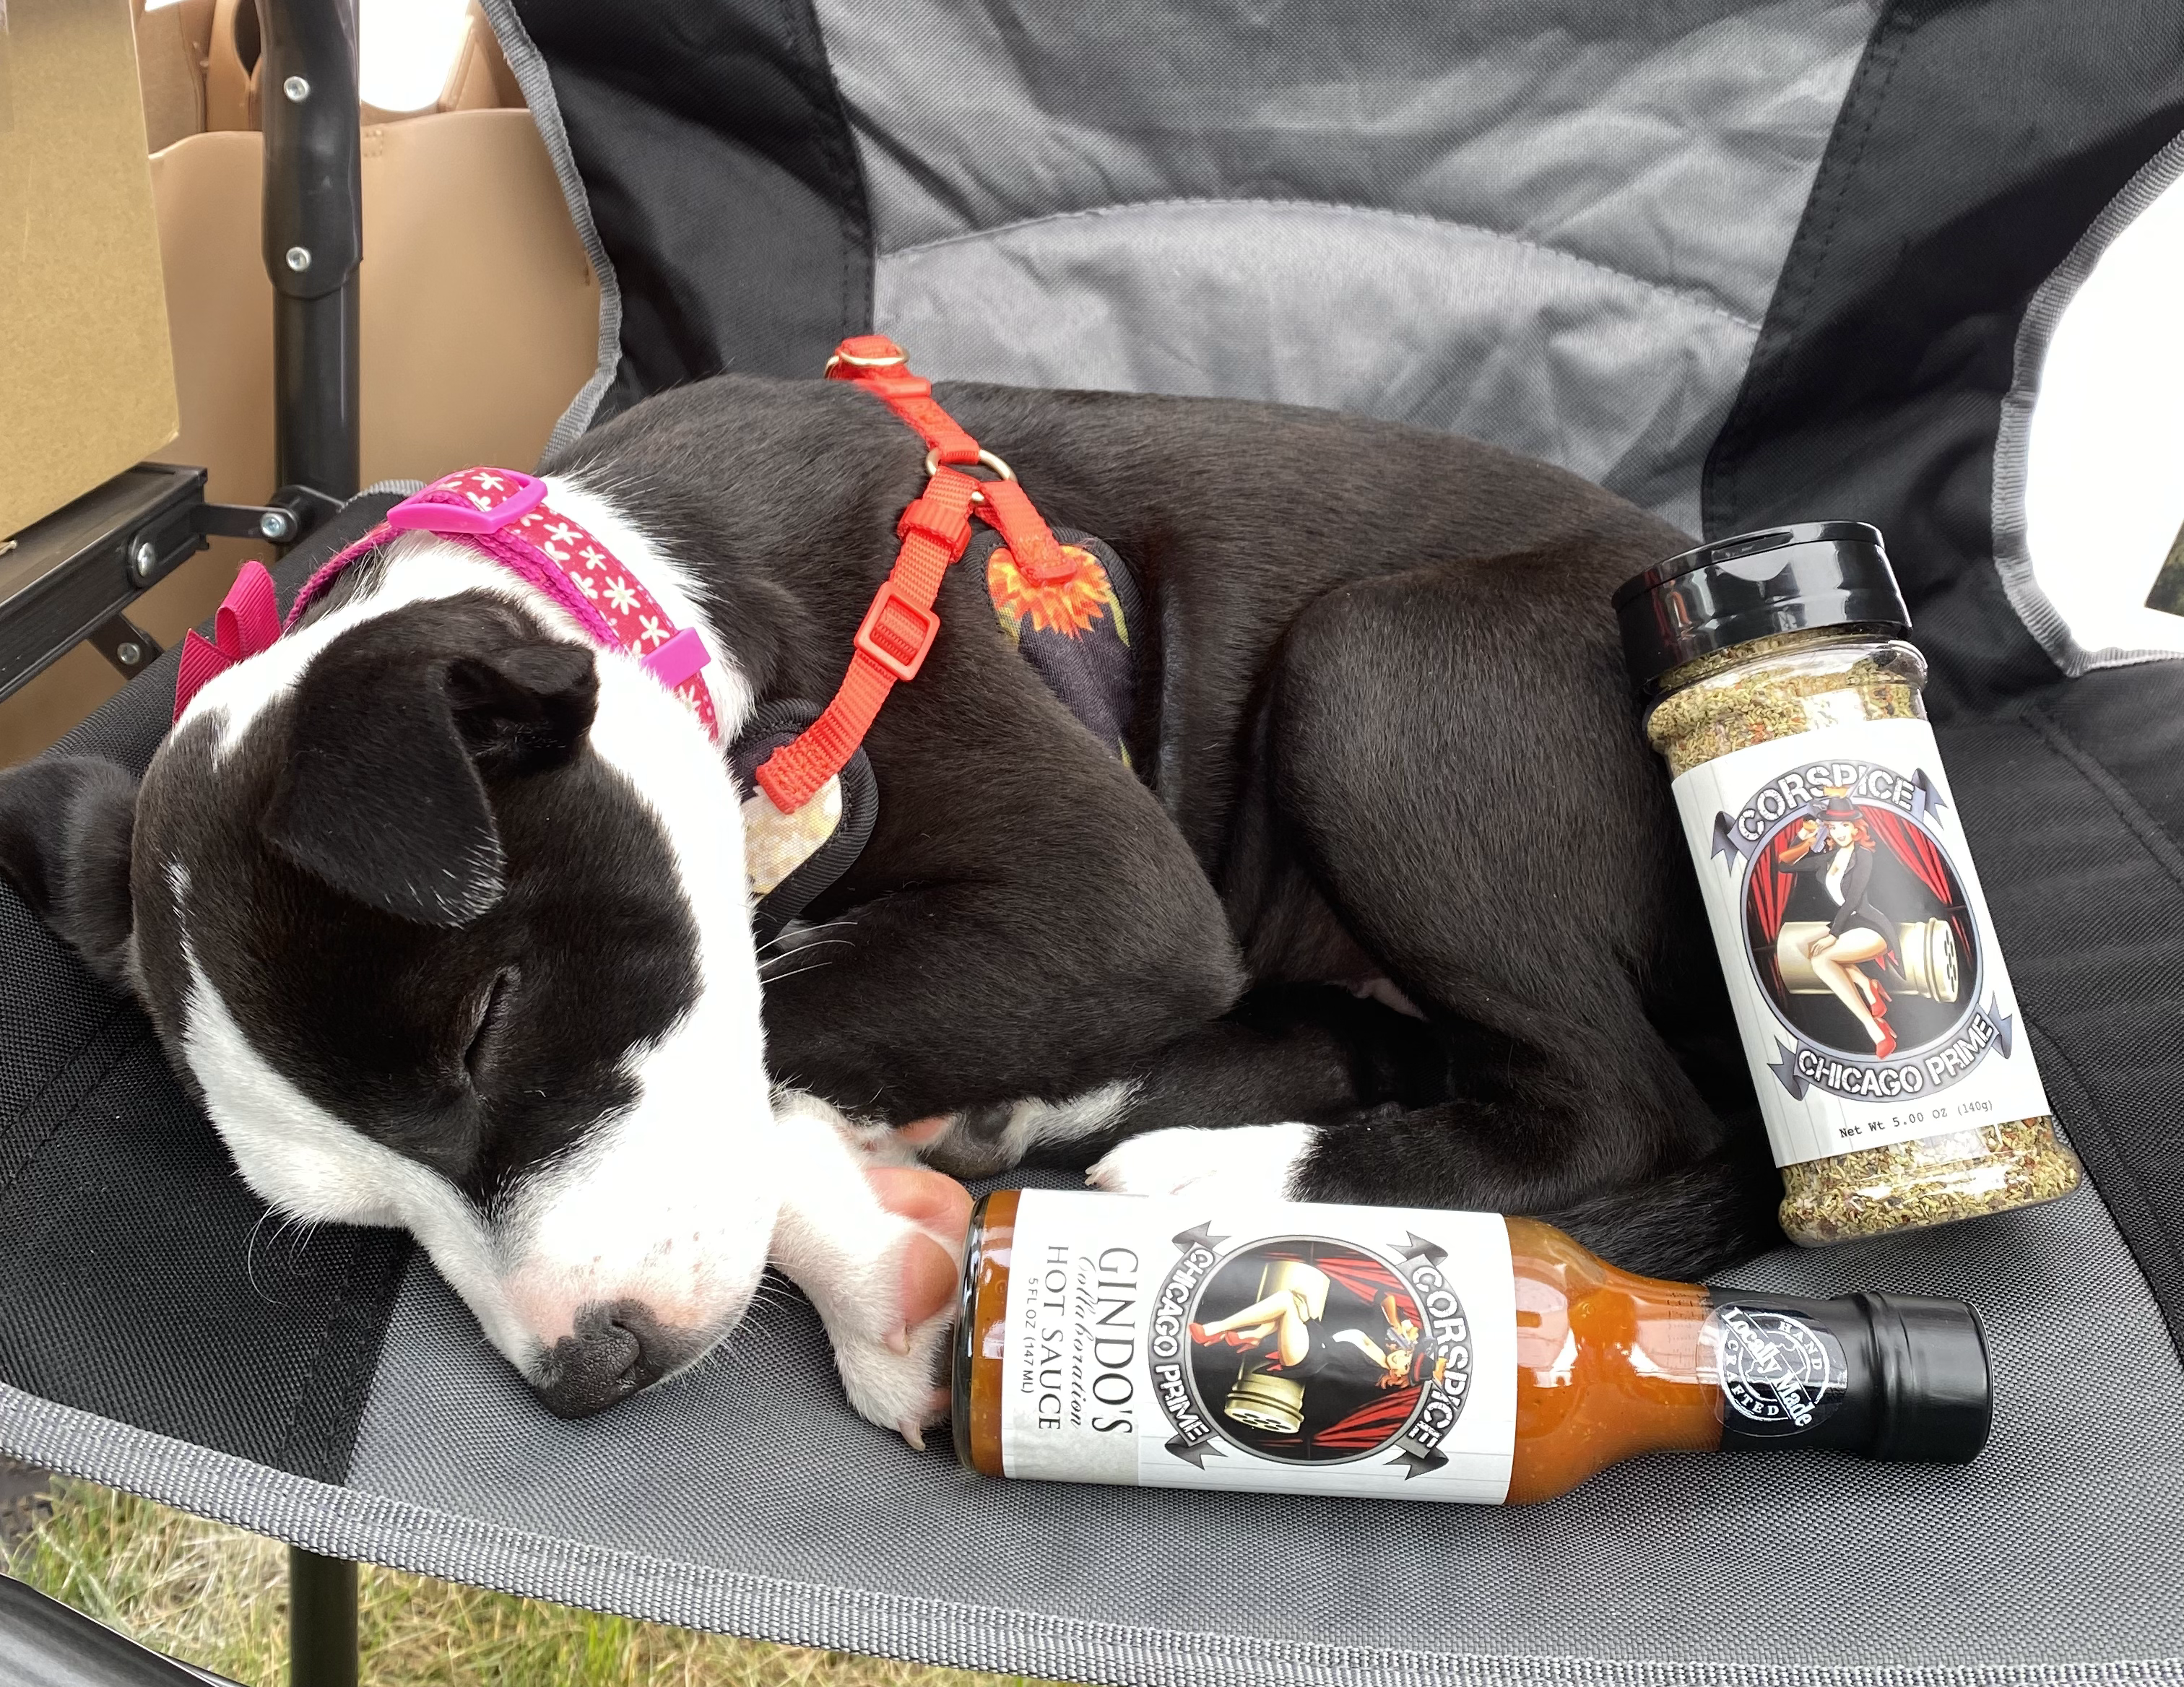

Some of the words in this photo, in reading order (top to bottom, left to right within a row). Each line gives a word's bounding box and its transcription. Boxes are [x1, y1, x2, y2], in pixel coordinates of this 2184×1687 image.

[1738, 763, 1915, 841] CORSPICE
[1797, 1049, 1924, 1097] CHICAGO
[1924, 1012, 1994, 1085] PRIME
[1839, 1125, 1863, 1138] Net
[1868, 1121, 1886, 1132] Wt
[1892, 1112, 1924, 1127] 5.00
[1957, 1099, 1993, 1116] (140g)
[1025, 1309, 1037, 1329] OZ
[1026, 1288, 1039, 1305] FL
[1028, 1277, 1039, 1285] 5
[1043, 1245, 1070, 1317] HOT
[1153, 1249, 1214, 1357] CHICAGO
[1023, 1336, 1036, 1366] (147
[1038, 1327, 1064, 1430] SAUCE
[1070, 1256, 1098, 1430] Collaboration
[1091, 1246, 1139, 1434] GINDO'S
[1408, 1266, 1469, 1449] CORSPICE
[1721, 1306, 1783, 1374] Locally
[1770, 1369, 1816, 1427] Made
[1725, 1339, 1780, 1416] CRAFTED
[1777, 1320, 1823, 1371] HAND
[1020, 1370, 1034, 1394] ML)
[1155, 1363, 1210, 1441] PRIME
